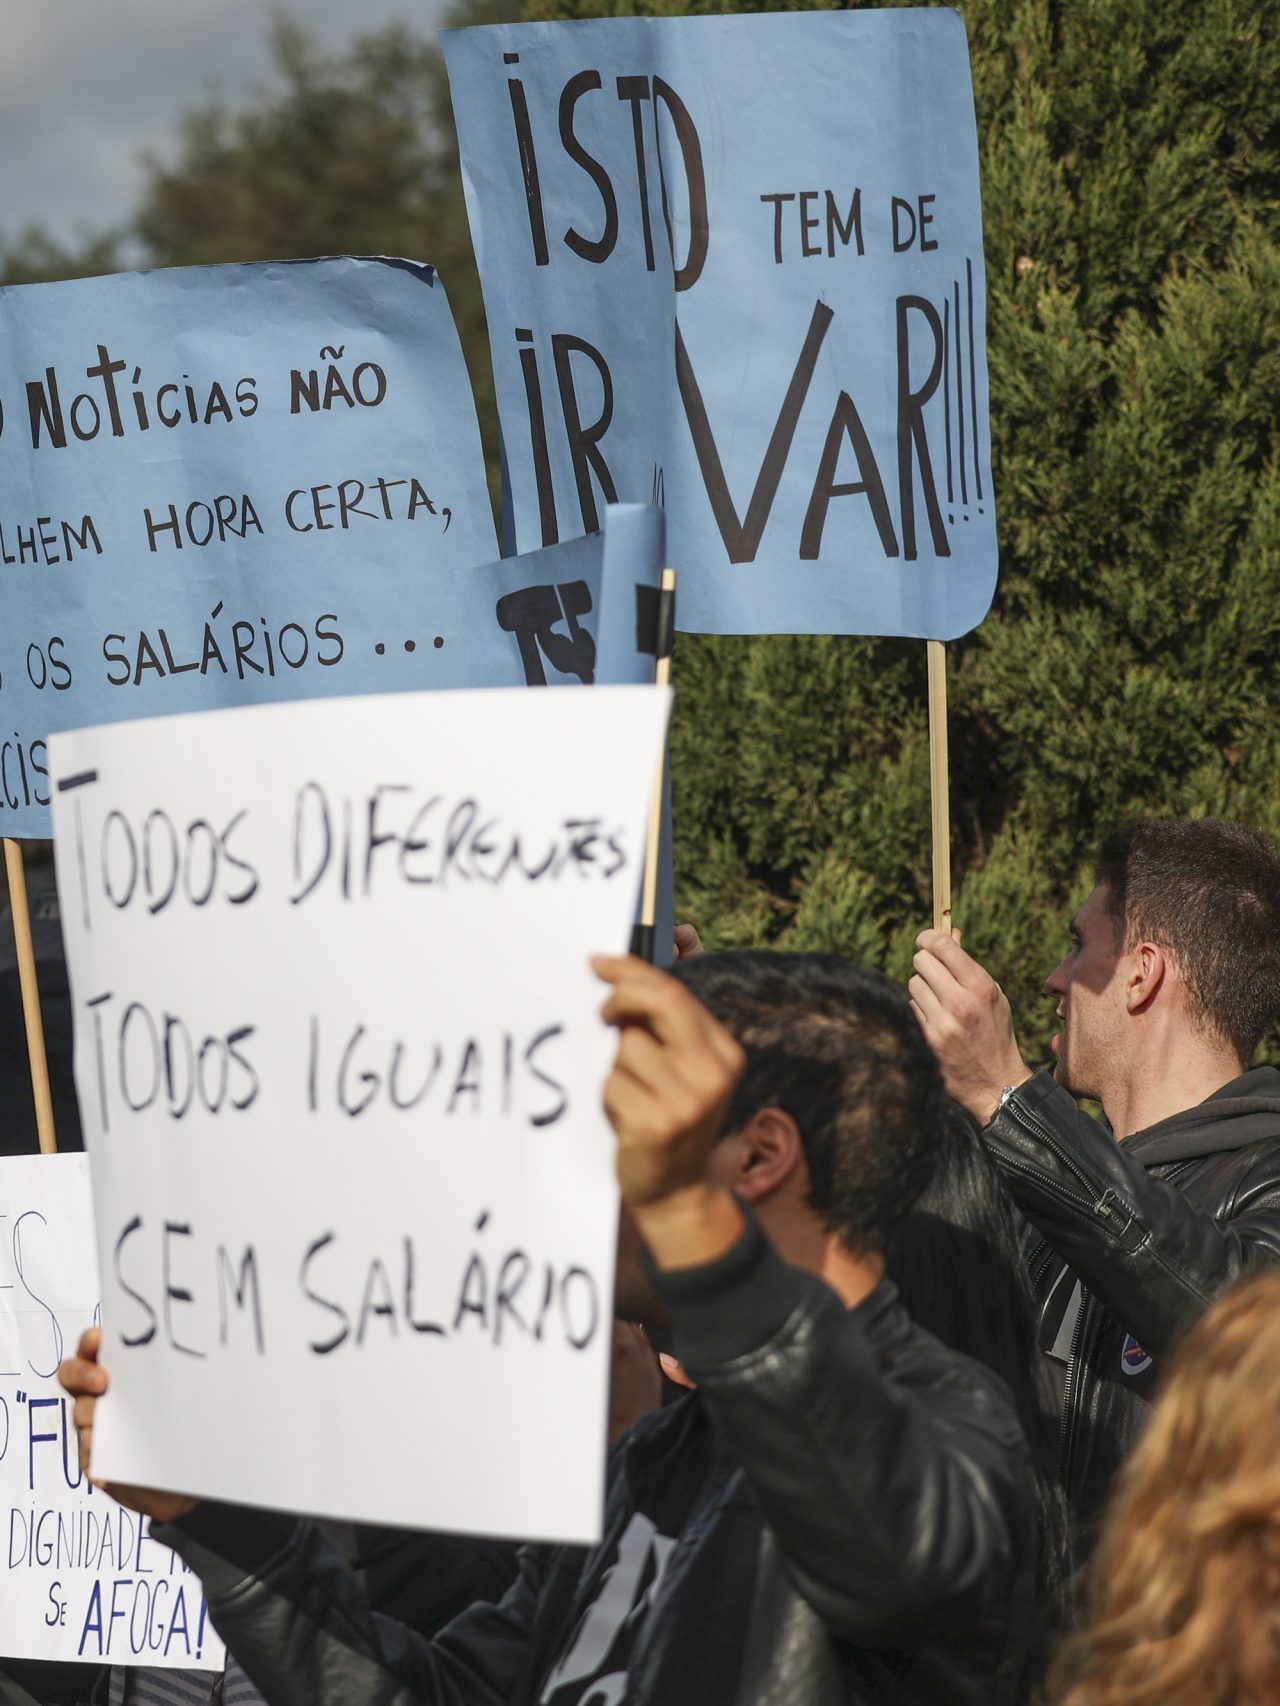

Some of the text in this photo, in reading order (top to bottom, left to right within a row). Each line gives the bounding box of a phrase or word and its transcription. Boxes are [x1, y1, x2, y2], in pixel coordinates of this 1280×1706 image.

[760, 188, 864, 264] TEM
[892, 194, 938, 252] DE
[290, 346, 386, 414] NÃO
[143, 495, 264, 551] HORA
[285, 477, 452, 534] CERTA,
[27, 637, 72, 690] OS
[57, 768, 259, 931] TODOS
[86, 992, 569, 1134] TODOS IGUAIS
[115, 1208, 601, 1358] SEM SALÁRIO
[78, 1579, 208, 1660] AFOGA!
